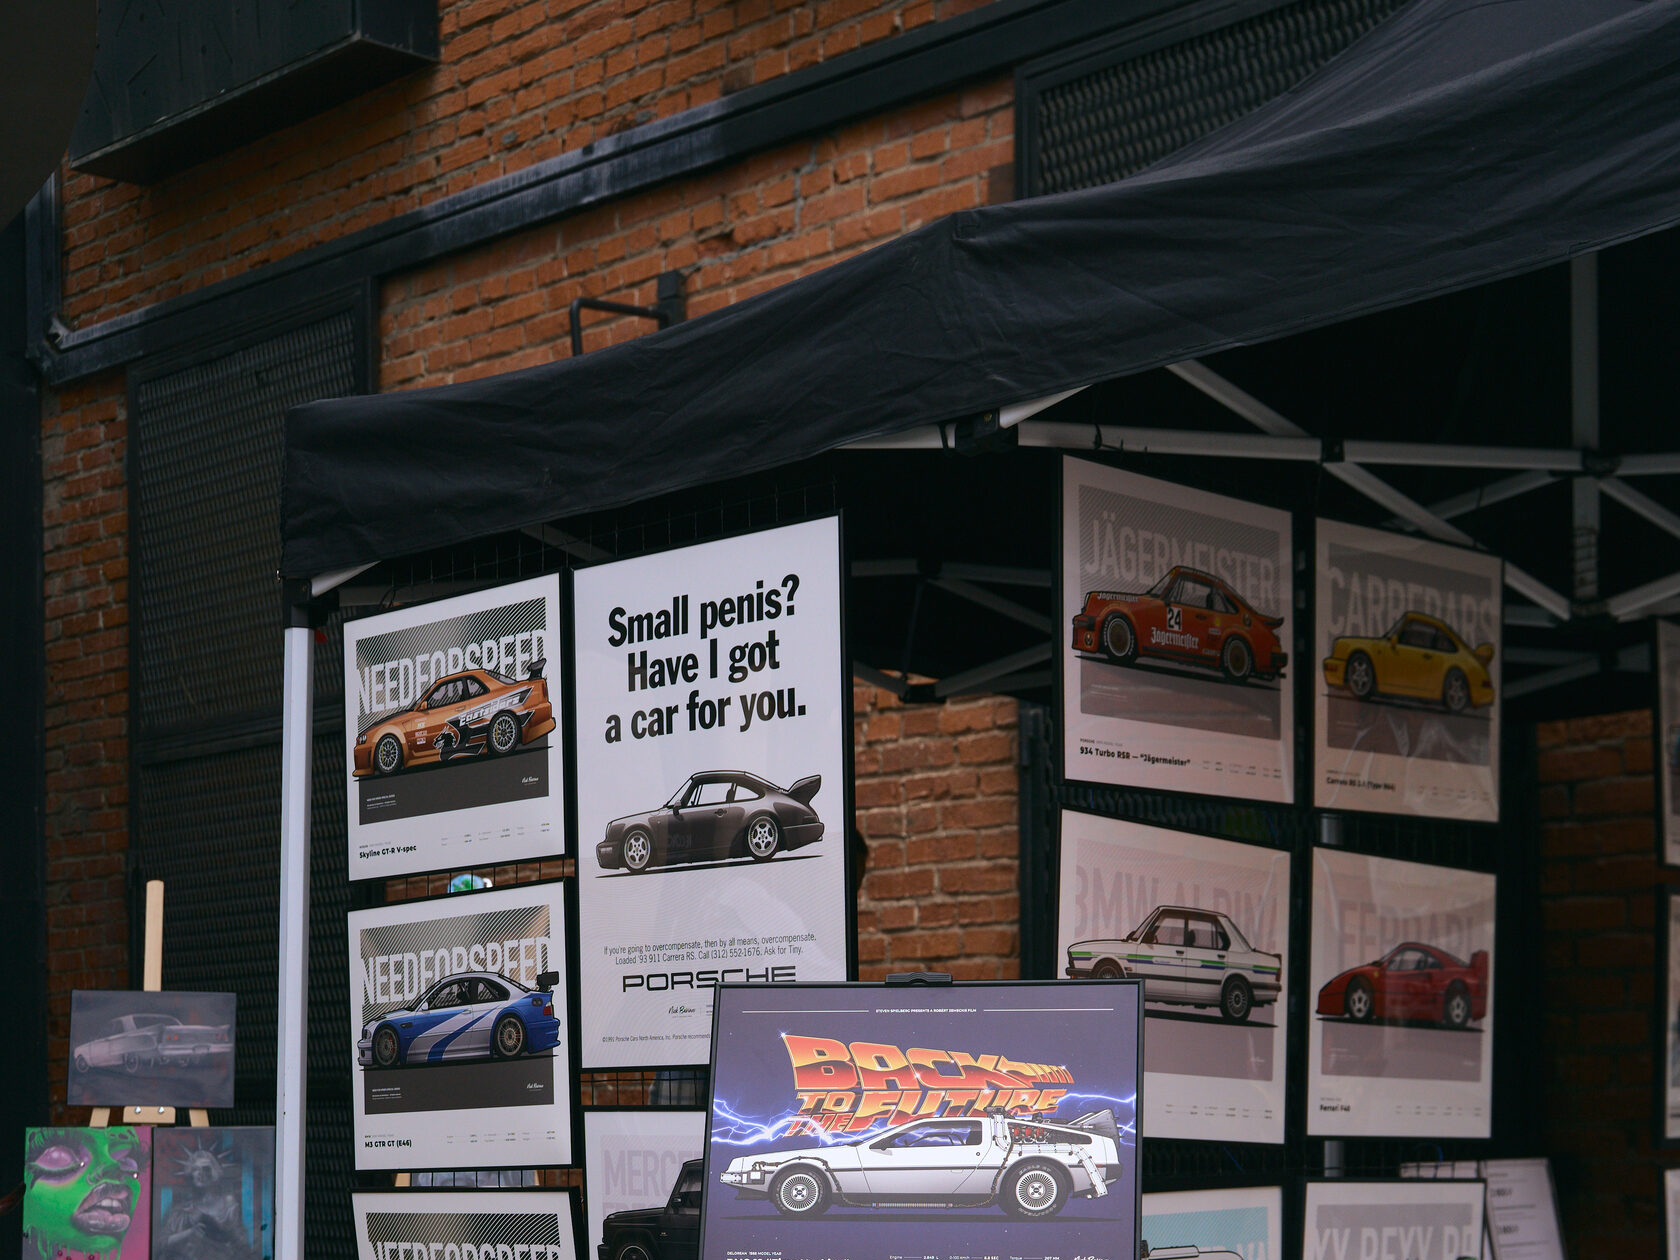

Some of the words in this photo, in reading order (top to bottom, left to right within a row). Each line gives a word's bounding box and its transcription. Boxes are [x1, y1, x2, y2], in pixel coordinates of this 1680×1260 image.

[608, 594, 689, 648] Small
[700, 574, 800, 640] penis?
[1167, 608, 1181, 630] 24
[628, 650, 699, 692] Have
[709, 638, 718, 679] I
[728, 630, 780, 683] got
[605, 713, 622, 744] a
[631, 704, 678, 739] car
[686, 690, 731, 731] for
[739, 687, 806, 732] you.
[1080, 746, 1093, 755] 934
[1095, 748, 1115, 758] Turbo
[1117, 751, 1130, 760] RSR
[359, 848, 380, 859] Skyline
[381, 846, 396, 856] GT-R
[397, 844, 417, 853] V-spec
[615, 955, 636, 965] Loaded
[649, 953, 660, 963] 911
[662, 952, 684, 962] Carrera
[698, 950, 710, 960] Call
[711, 949, 728, 959] (312)
[764, 946, 776, 955] Ask
[777, 945, 786, 955] for
[789, 944, 803, 955] Tiny.
[627, 944, 643, 955] going
[645, 944, 651, 952] to
[704, 939, 718, 948] then
[719, 938, 727, 948] by
[622, 965, 796, 993] PORSCHE
[782, 1035, 1074, 1089] BACK
[796, 1091, 856, 1114] TO
[846, 1088, 1067, 1132] FUTURE
[784, 1112, 854, 1138] THE
[374, 1140, 386, 1148] GTR
[387, 1139, 395, 1147] GT
[396, 1139, 412, 1148] (E46)
